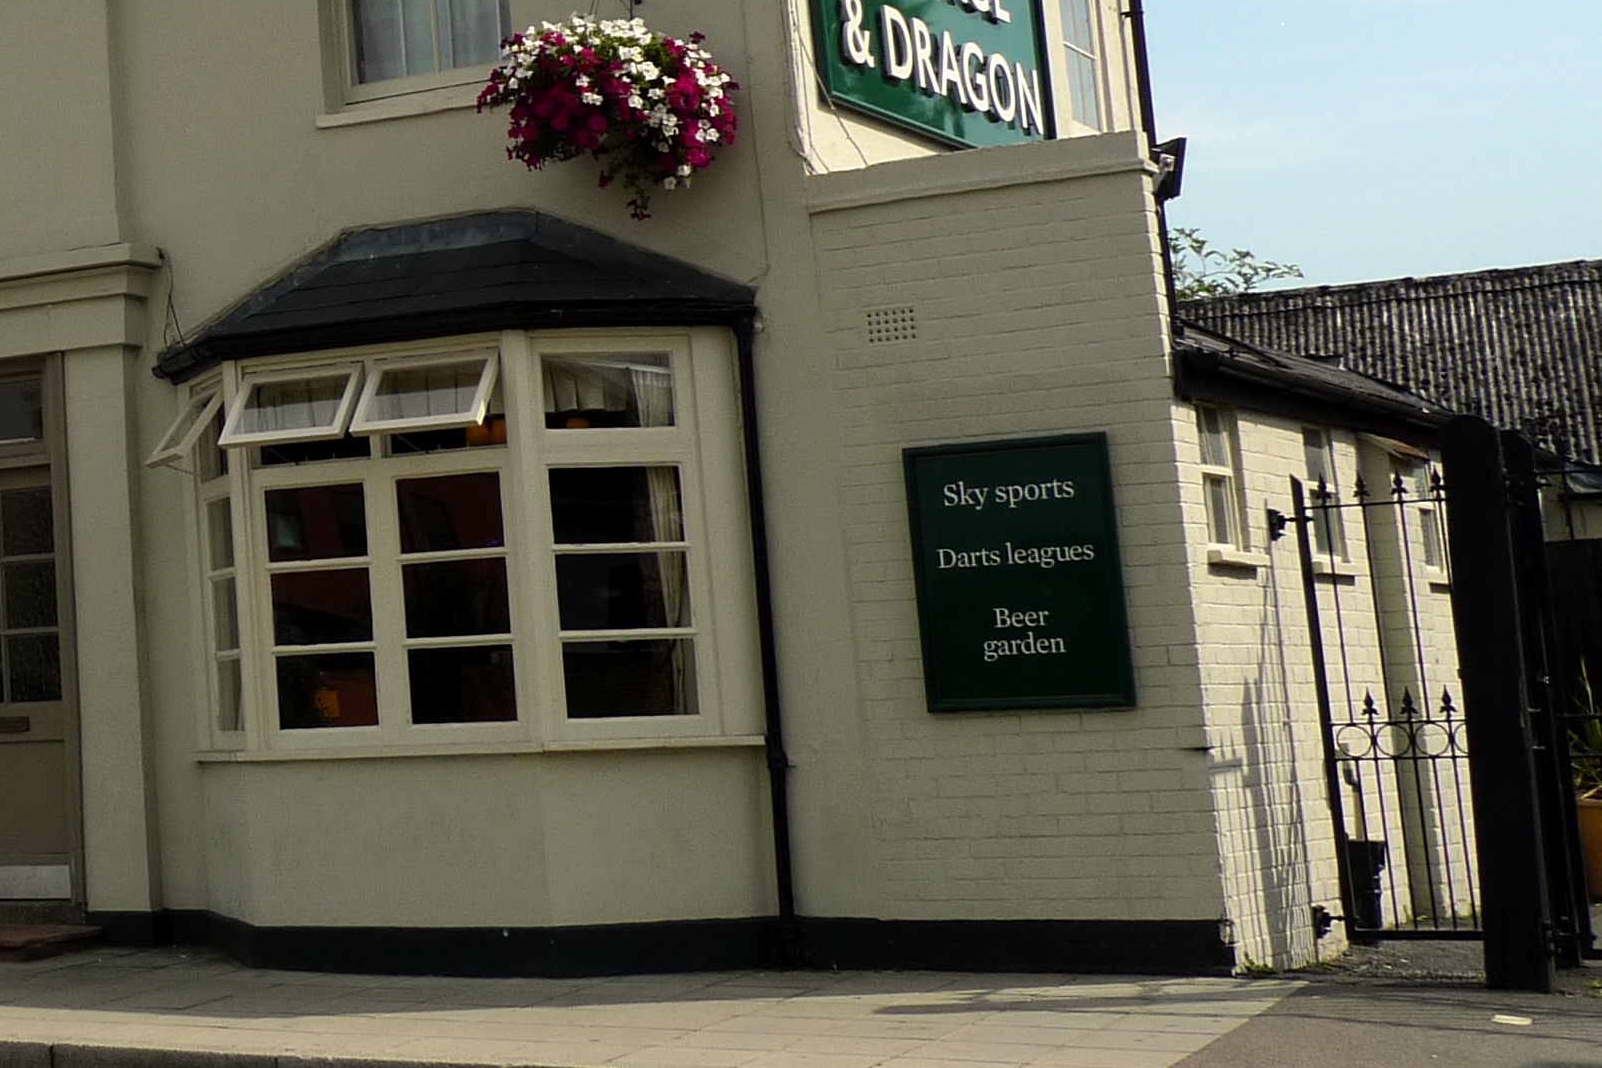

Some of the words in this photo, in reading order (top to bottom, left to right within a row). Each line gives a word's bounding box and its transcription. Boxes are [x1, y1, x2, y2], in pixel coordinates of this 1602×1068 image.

[880, 4, 1044, 135] DRAGON
[943, 480, 989, 510] Sky
[994, 478, 1075, 509] sports
[936, 547, 1002, 569] Darts
[1004, 541, 1095, 569] leagues
[992, 607, 1050, 628] Beer
[983, 631, 1068, 662] garden
